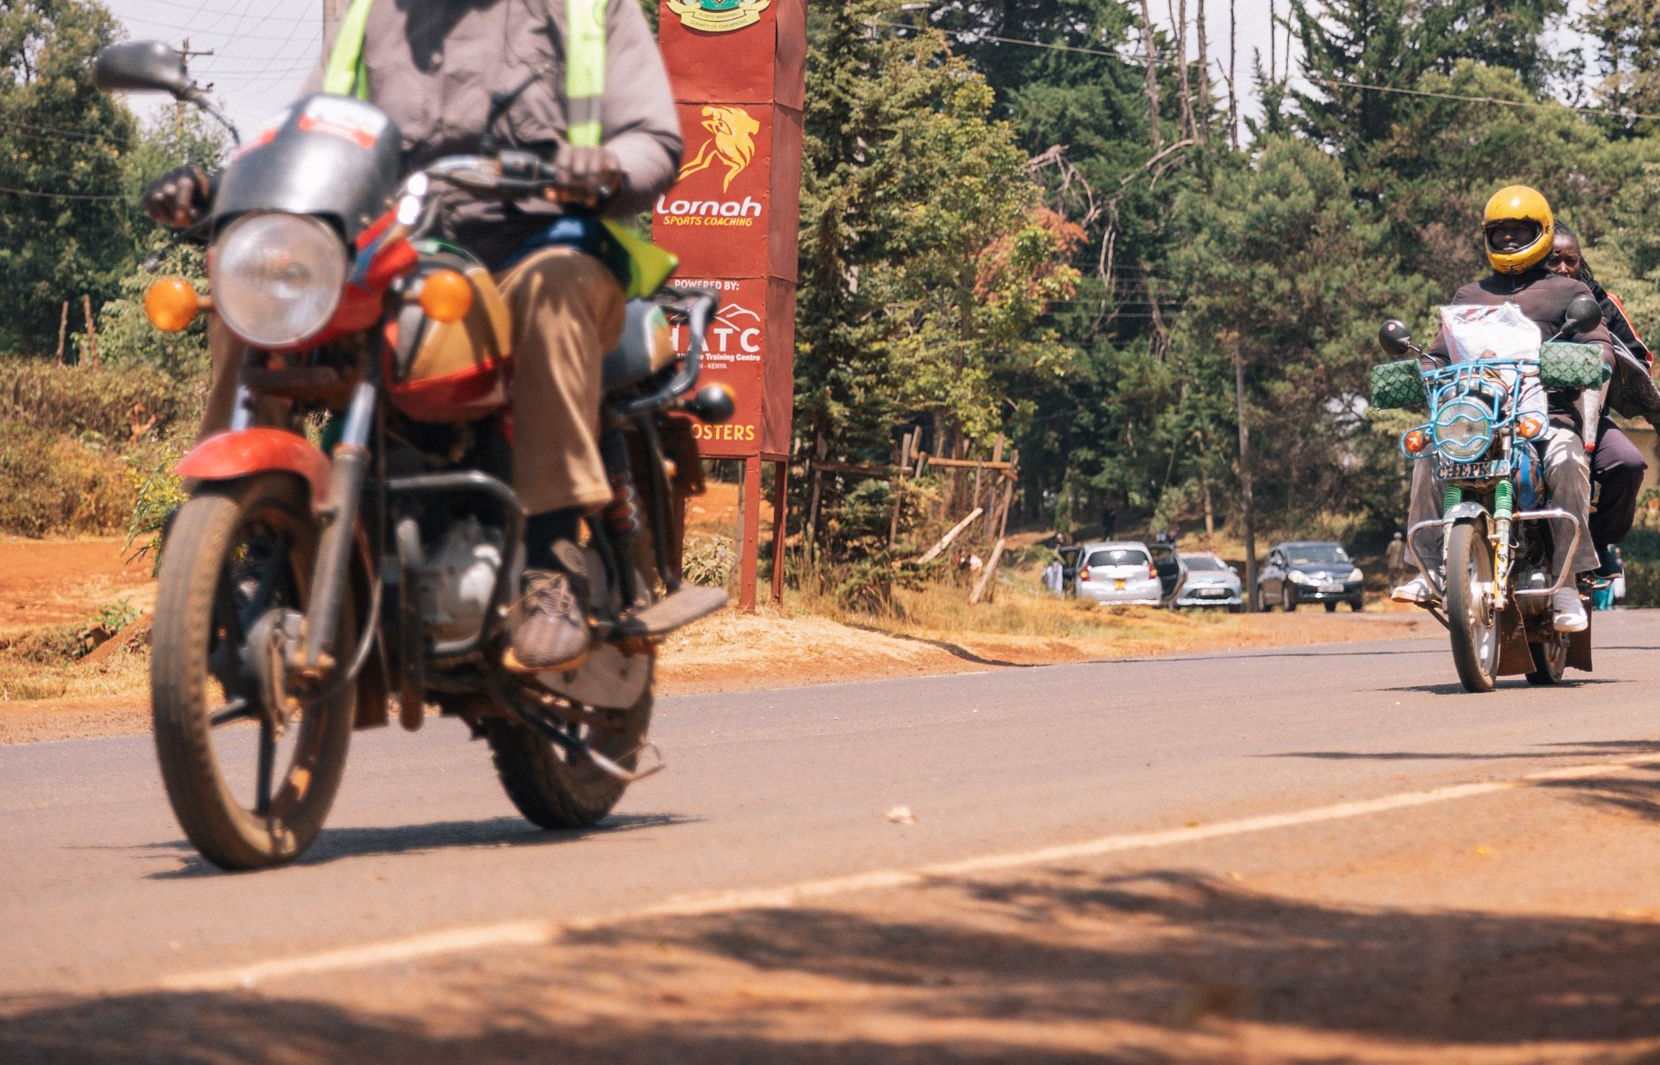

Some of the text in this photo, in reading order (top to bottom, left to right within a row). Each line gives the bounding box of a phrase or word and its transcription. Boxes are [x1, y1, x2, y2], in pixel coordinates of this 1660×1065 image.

[656, 194, 762, 217] Lornah
[663, 216, 753, 227] SPORTS COACHING
[724, 280, 740, 291] BY:
[672, 327, 761, 353] TC
[705, 352, 735, 363] Training
[691, 423, 755, 441] OSTERS
